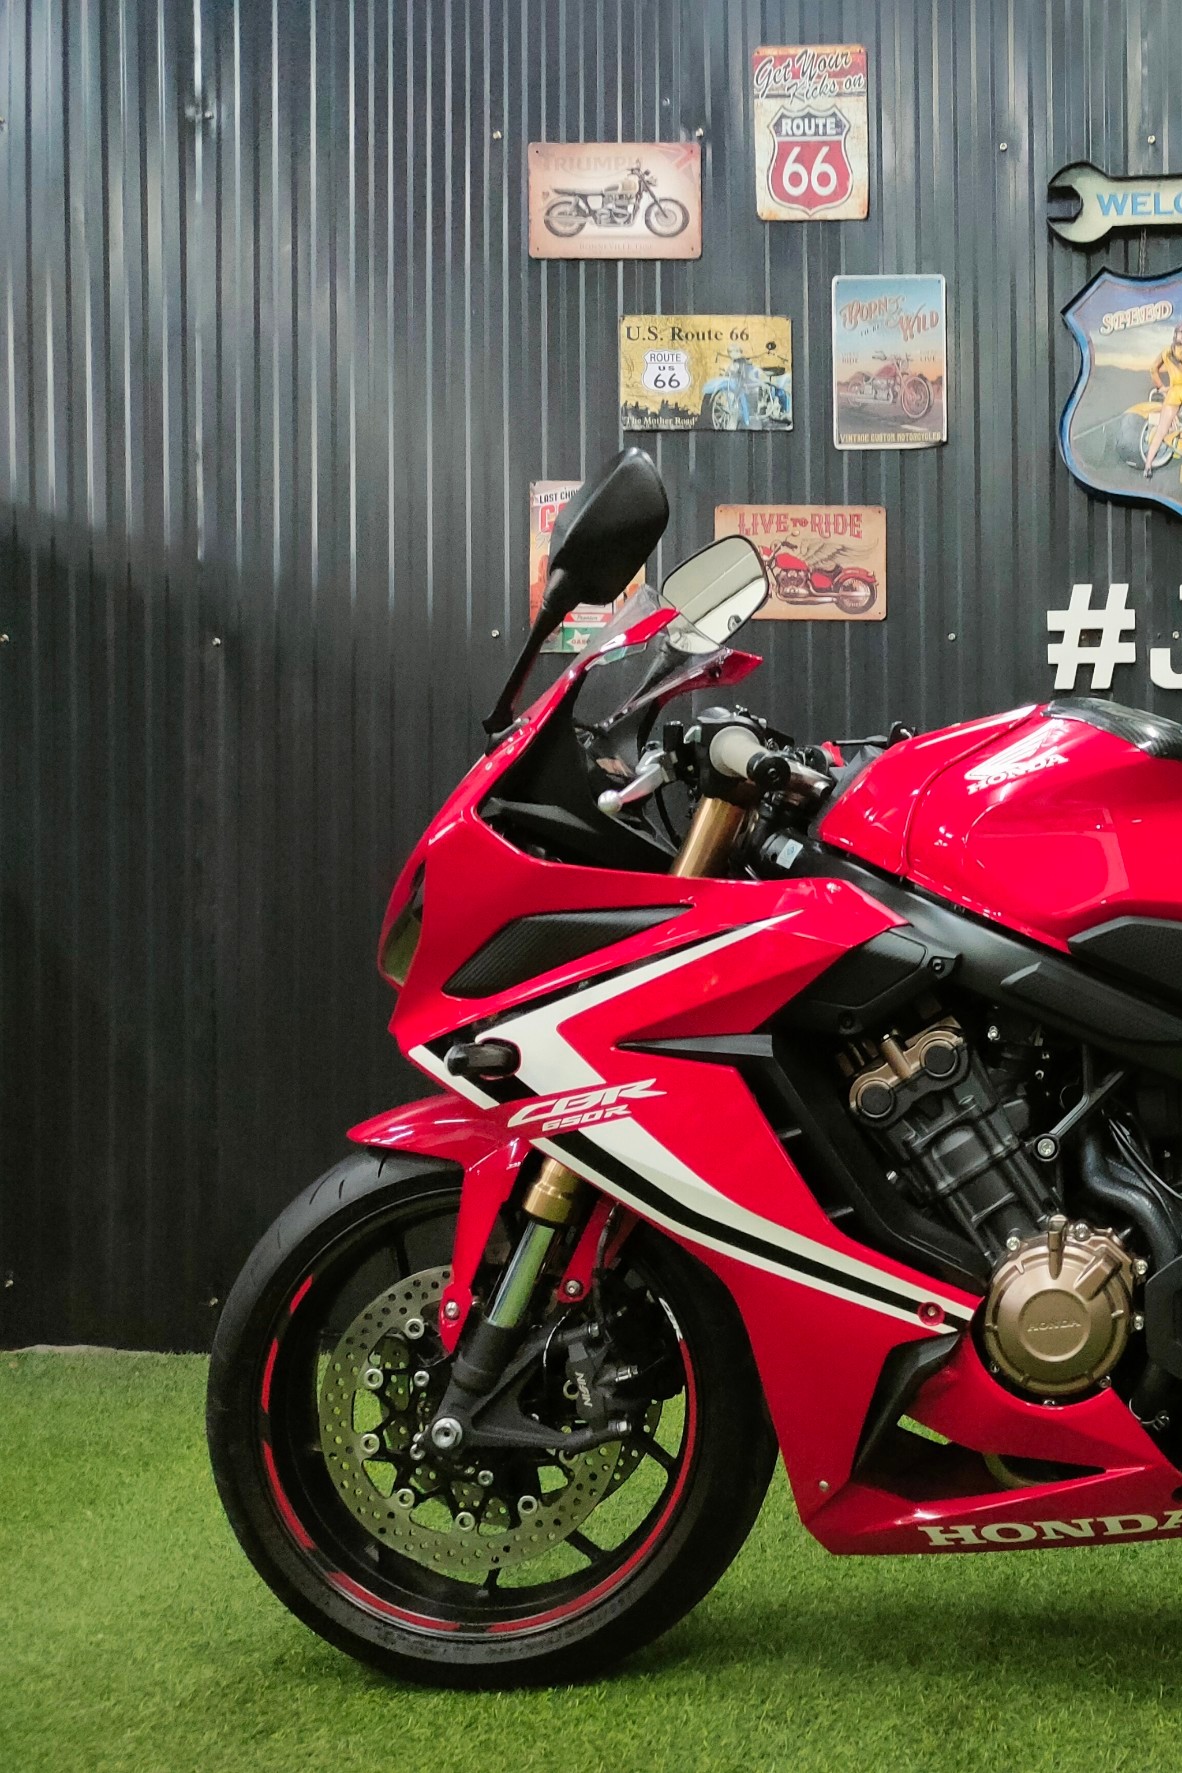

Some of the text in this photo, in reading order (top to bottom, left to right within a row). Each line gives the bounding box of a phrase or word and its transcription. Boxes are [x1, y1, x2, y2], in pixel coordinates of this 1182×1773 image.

[754, 49, 852, 100] Get Your
[786, 73, 865, 106] Kicks on
[781, 117, 837, 136] ROUTE
[782, 146, 837, 197] 66
[899, 303, 939, 342] WILD
[1101, 300, 1173, 334] SPEED
[625, 326, 750, 342] U.S. Route 66
[650, 353, 681, 362] ROUTE
[653, 373, 681, 389] 66
[643, 416, 673, 426] Mother
[540, 493, 558, 504] LAST
[737, 512, 863, 539] LIVE TO RIDE
[967, 752, 1069, 795] HONDA
[507, 1078, 667, 1128] CBR
[542, 1104, 632, 1132] 650R
[1027, 1319, 1081, 1332] HONDA
[575, 1371, 593, 1407] NISSIN
